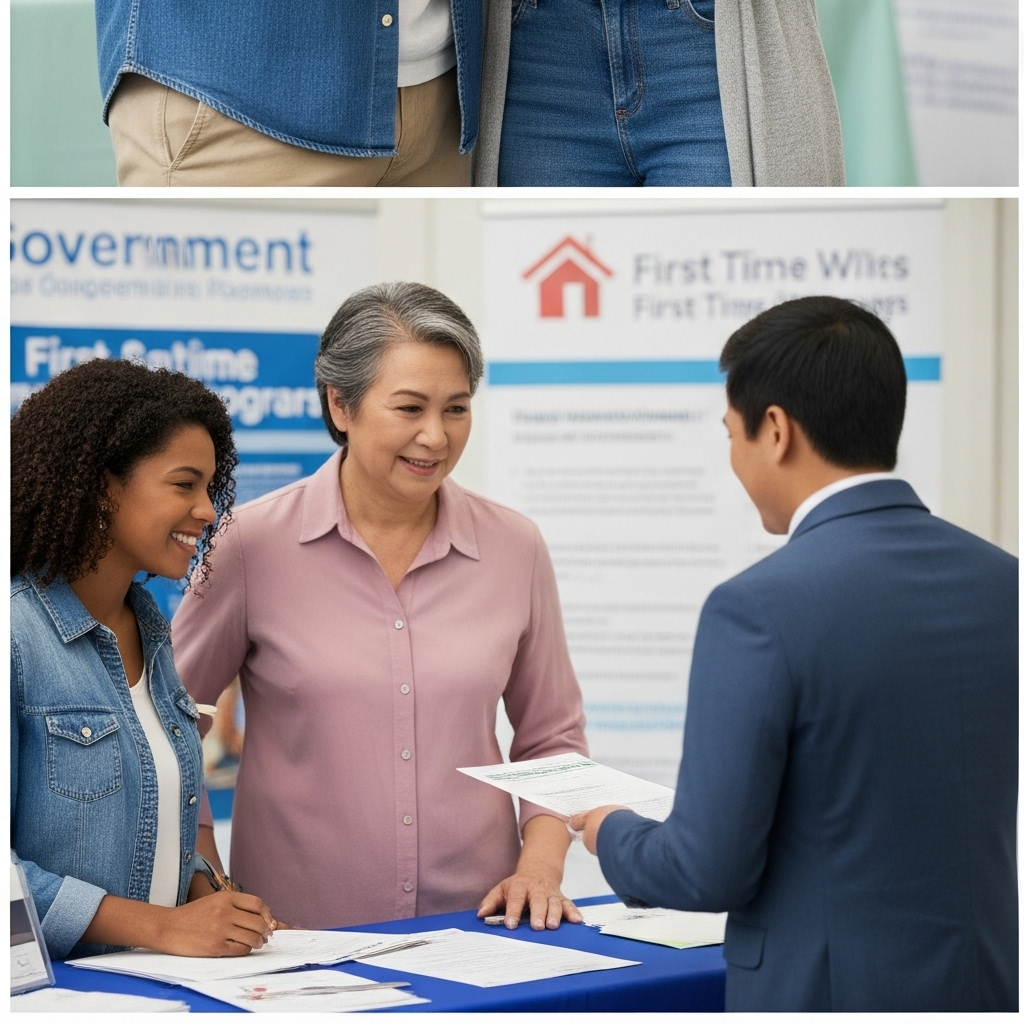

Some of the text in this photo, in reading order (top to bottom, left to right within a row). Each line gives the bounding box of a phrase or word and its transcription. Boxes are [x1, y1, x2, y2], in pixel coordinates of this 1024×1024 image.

[10, 226, 314, 274] overnment
[633, 252, 711, 284] First
[721, 249, 809, 282] Time
